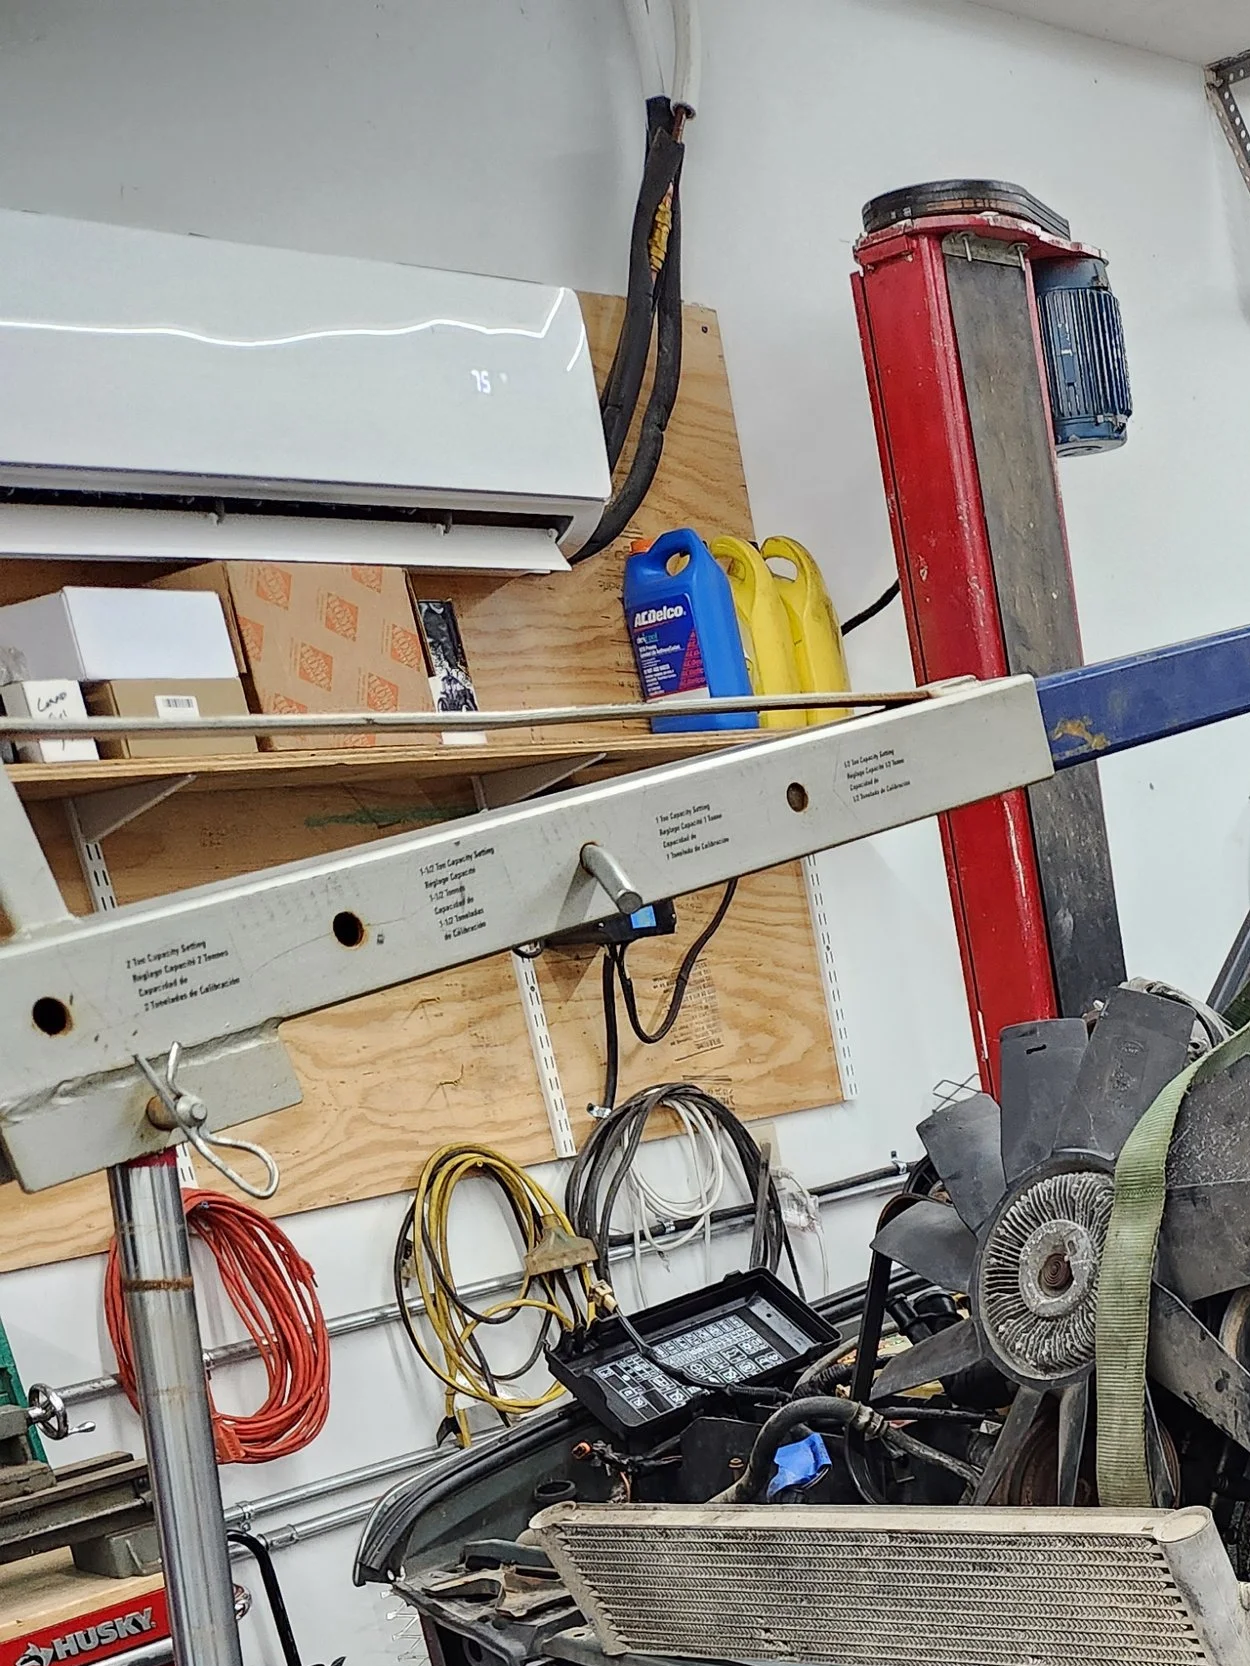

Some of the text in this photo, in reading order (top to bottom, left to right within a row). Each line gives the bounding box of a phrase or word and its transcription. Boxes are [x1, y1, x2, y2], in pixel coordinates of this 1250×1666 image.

[470, 370, 490, 394] 75
[634, 604, 684, 628] ACDelco
[147, 948, 180, 962] Capacity
[181, 941, 206, 953] Setting
[52, 1606, 153, 1660] HUSKY
